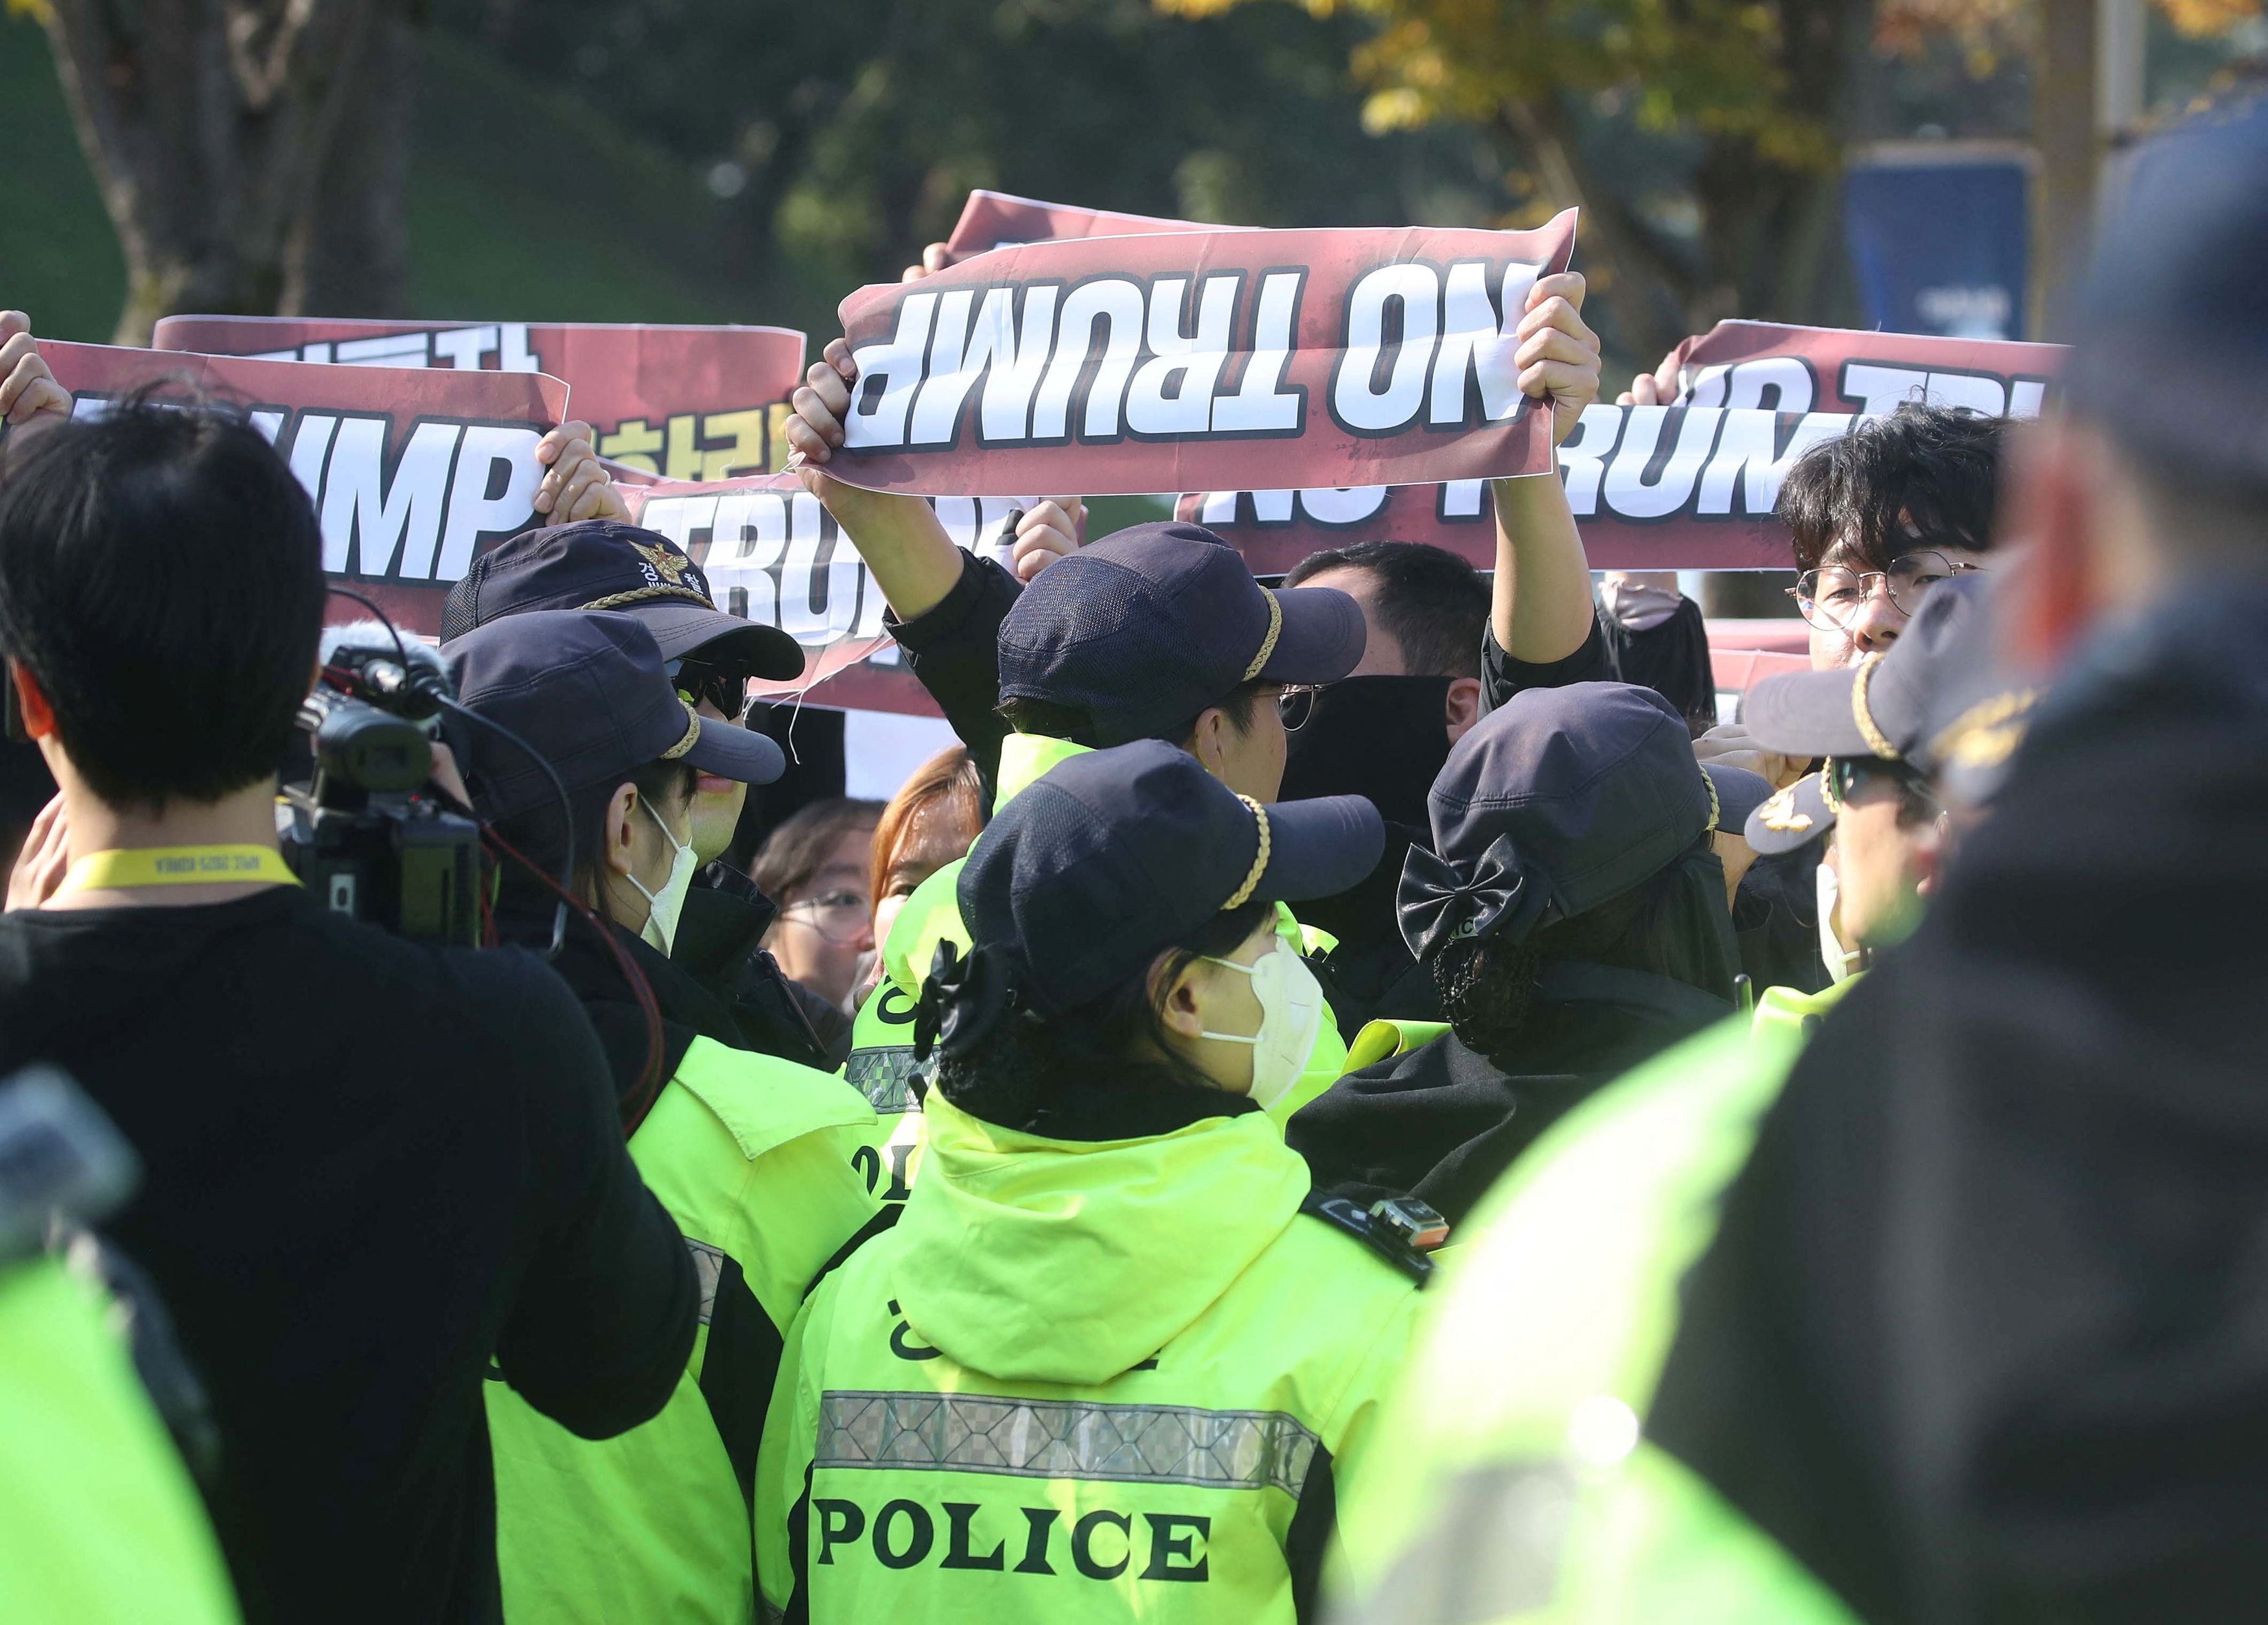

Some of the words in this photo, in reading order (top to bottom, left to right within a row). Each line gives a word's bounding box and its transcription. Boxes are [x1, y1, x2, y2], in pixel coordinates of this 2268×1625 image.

[843, 272, 1299, 449] TRUMP
[1334, 262, 1544, 431] NO
[812, 1498, 1211, 1582] POLICE
